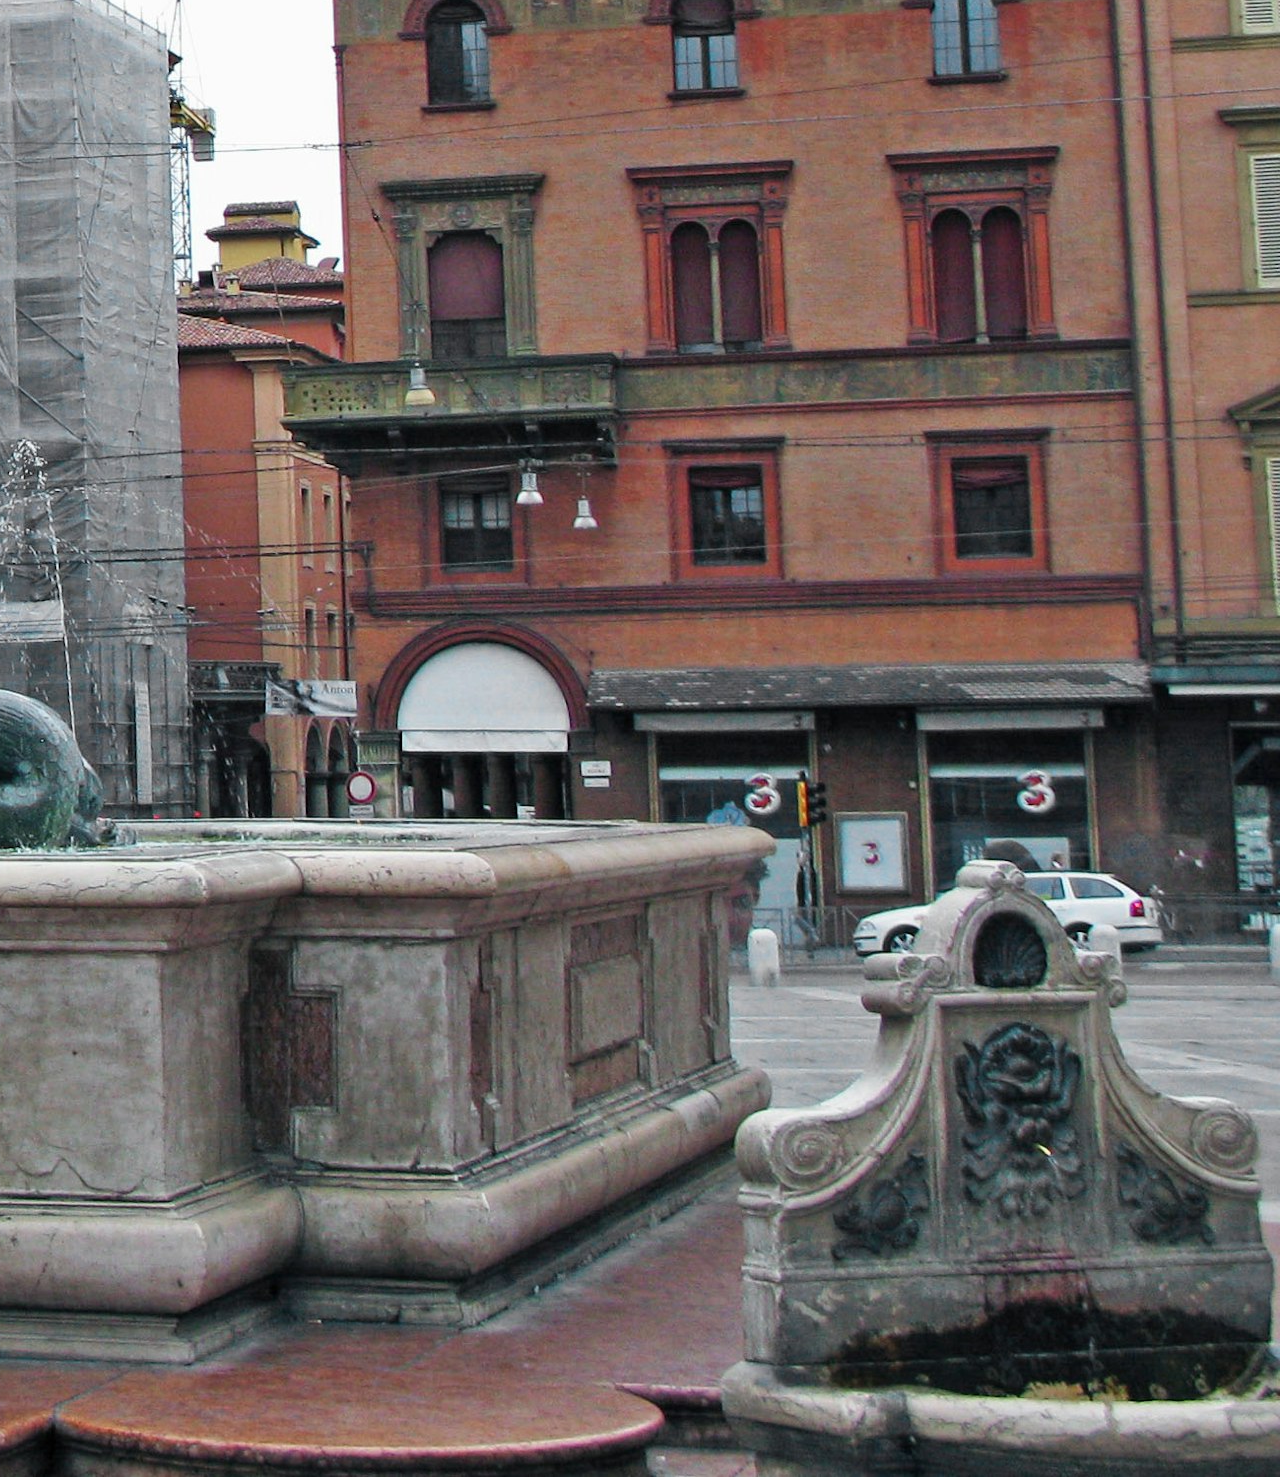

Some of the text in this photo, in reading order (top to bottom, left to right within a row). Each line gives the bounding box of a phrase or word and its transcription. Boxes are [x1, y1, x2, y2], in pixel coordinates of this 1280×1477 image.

[744, 773, 781, 815] 3
[1017, 770, 1055, 814] 3
[861, 841, 880, 866] 3
